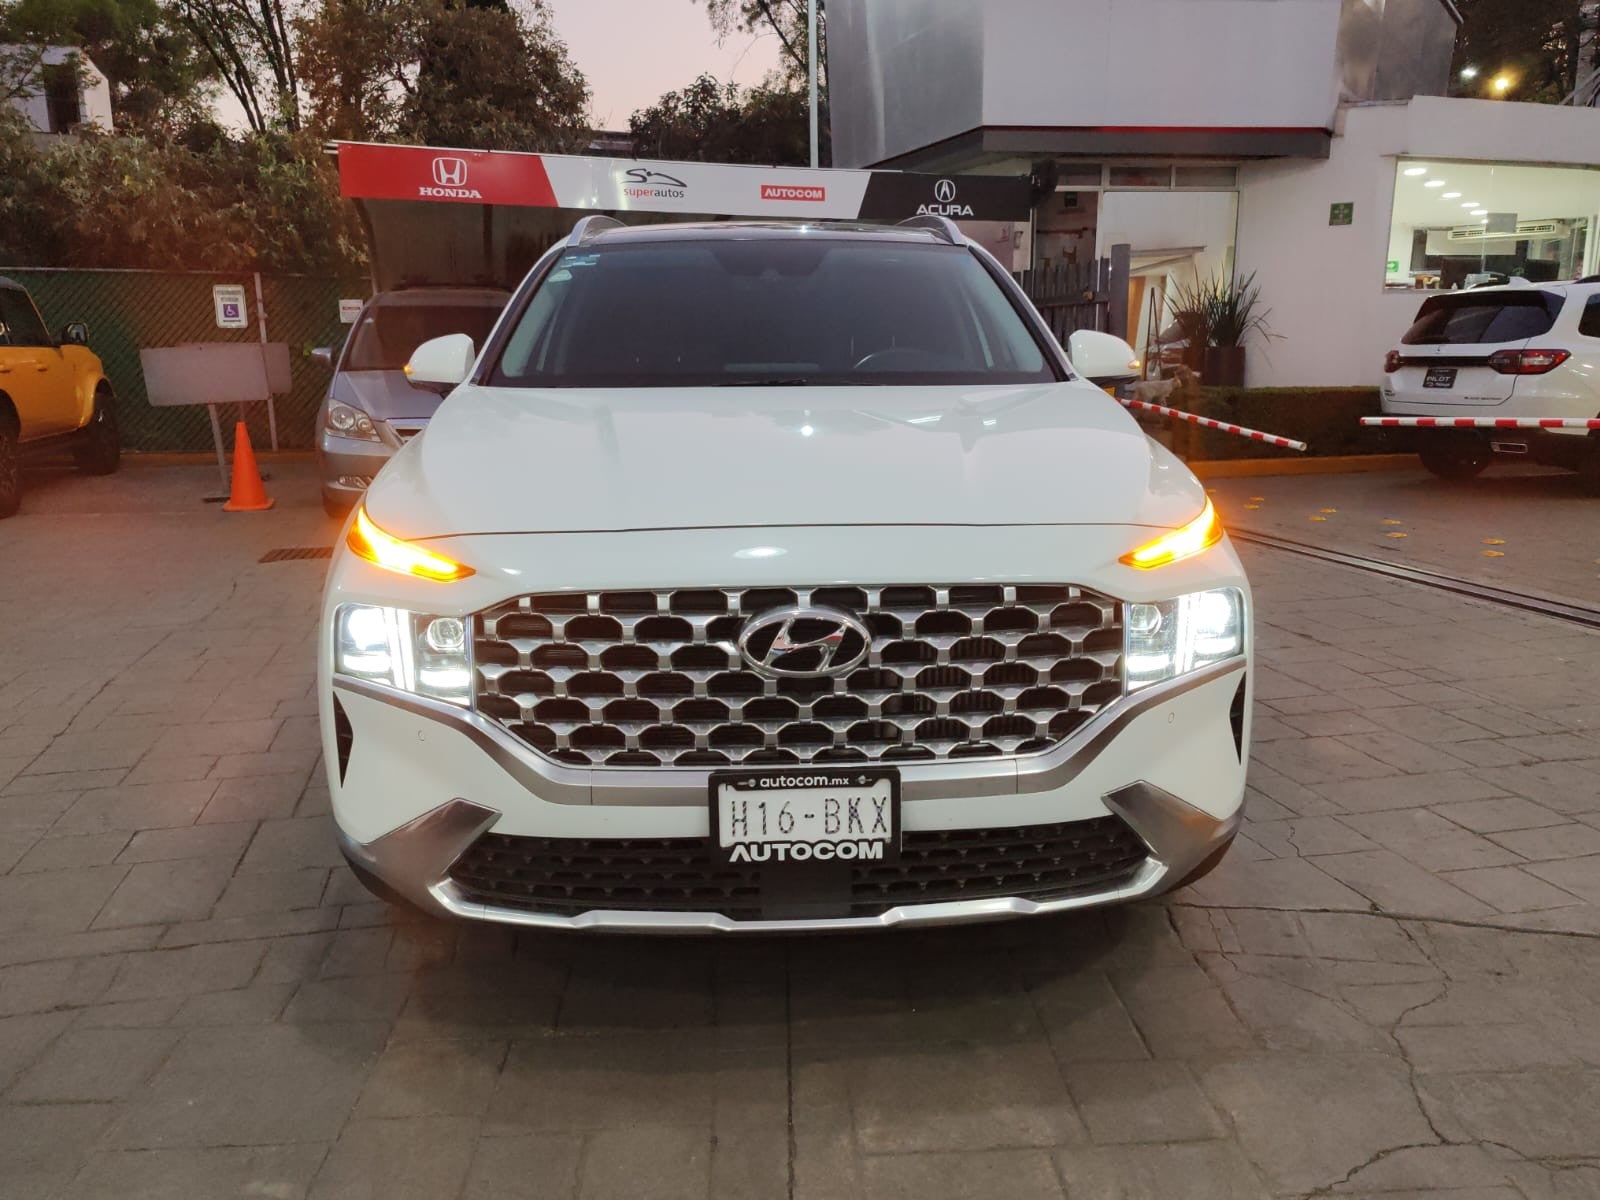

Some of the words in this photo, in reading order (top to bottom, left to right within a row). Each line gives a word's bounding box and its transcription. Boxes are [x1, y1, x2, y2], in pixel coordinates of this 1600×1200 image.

[419, 187, 482, 199] HONDA
[623, 188, 685, 198] superautos
[764, 187, 823, 199] AUTOCOM
[916, 203, 975, 217] ACURA
[1426, 375, 1452, 383] PILOT
[760, 775, 850, 788] autocom.mx
[731, 796, 888, 837] H16-BKX
[729, 841, 884, 863] AUTOCOM
